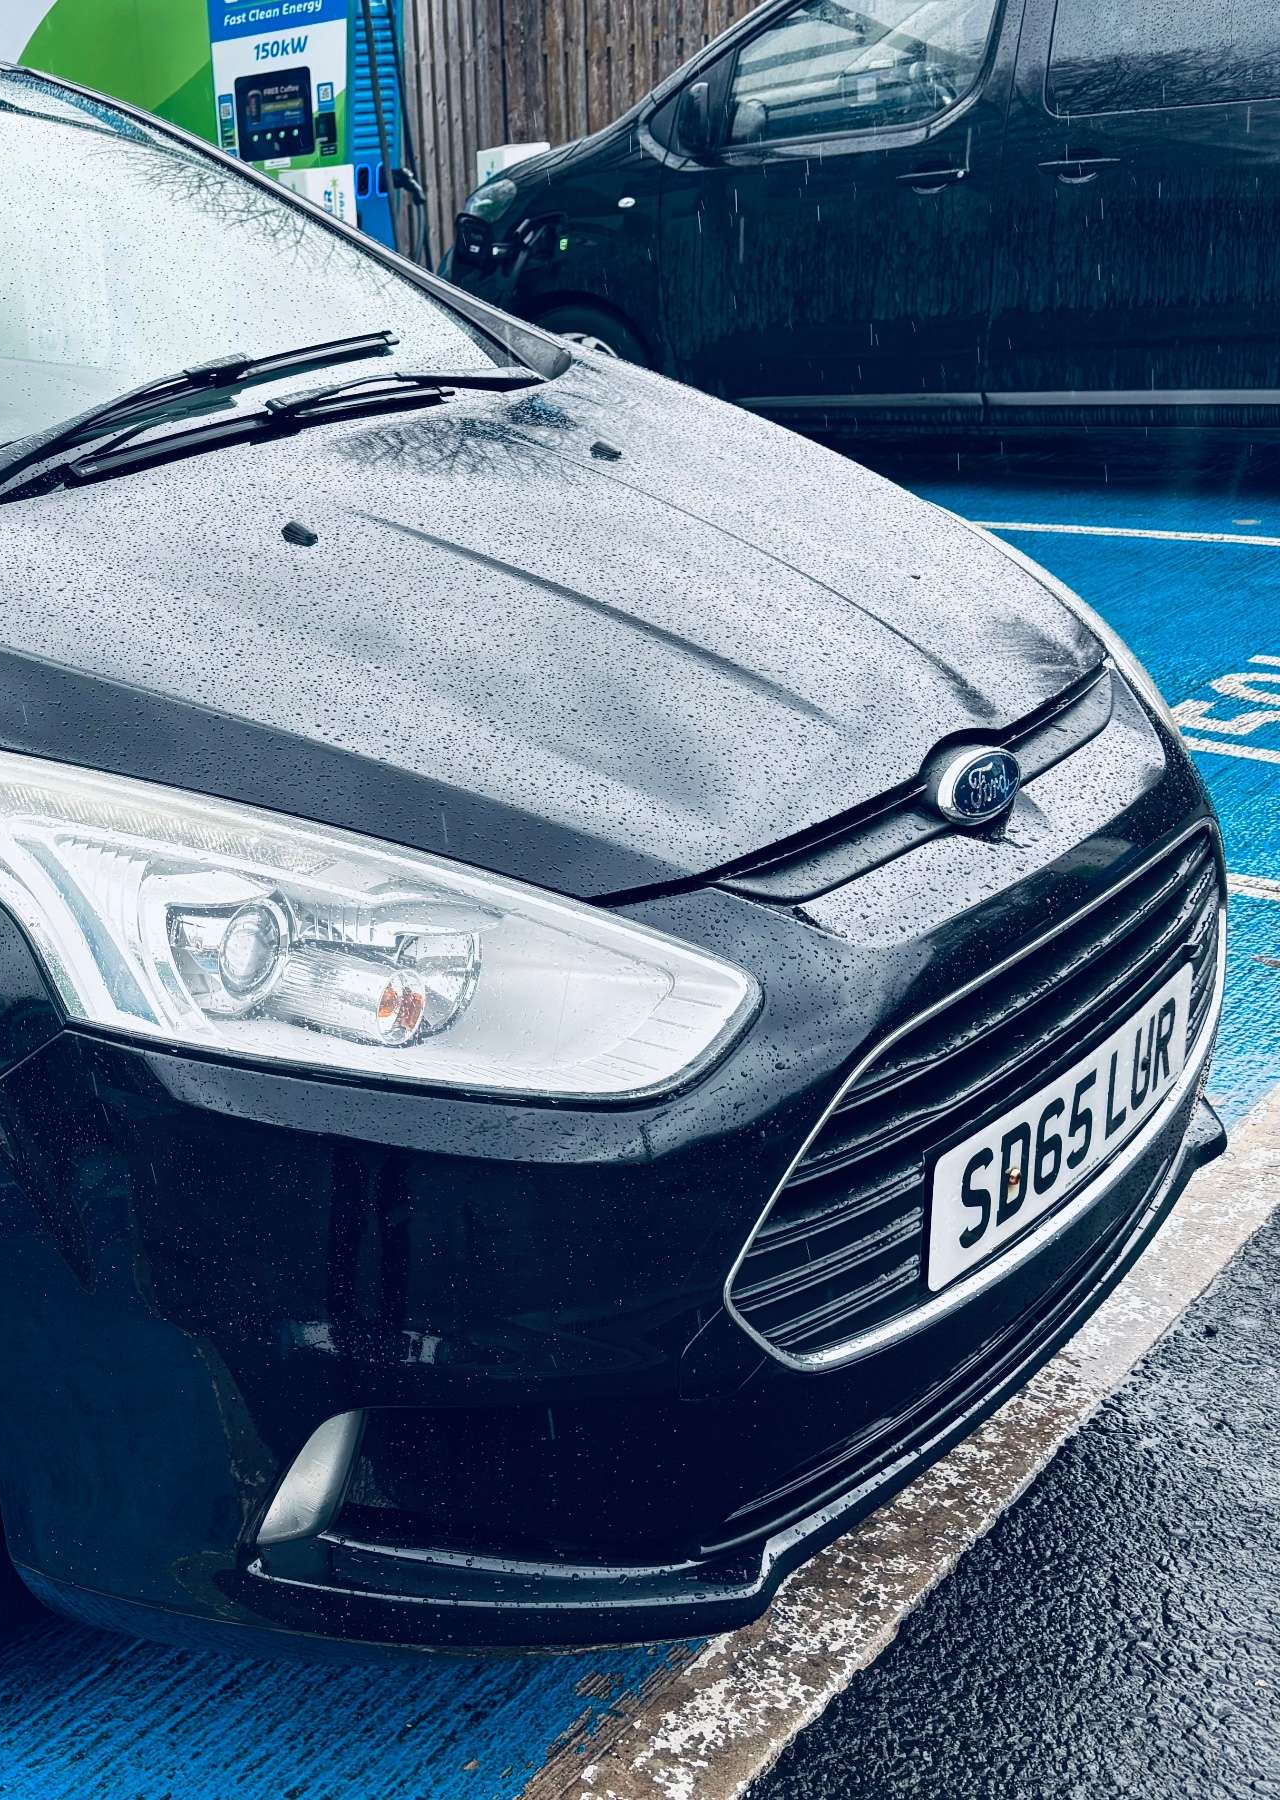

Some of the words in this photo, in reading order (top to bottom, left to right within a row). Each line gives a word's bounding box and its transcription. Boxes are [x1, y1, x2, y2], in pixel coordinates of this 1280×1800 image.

[223, 14, 247, 27] Fast
[248, 8, 280, 22] Clean
[282, 0, 323, 15] Energy
[254, 35, 308, 61] 150kW
[967, 761, 1019, 810] Ford
[959, 1068, 1097, 1249] SD65
[1105, 997, 1177, 1141] LUR
